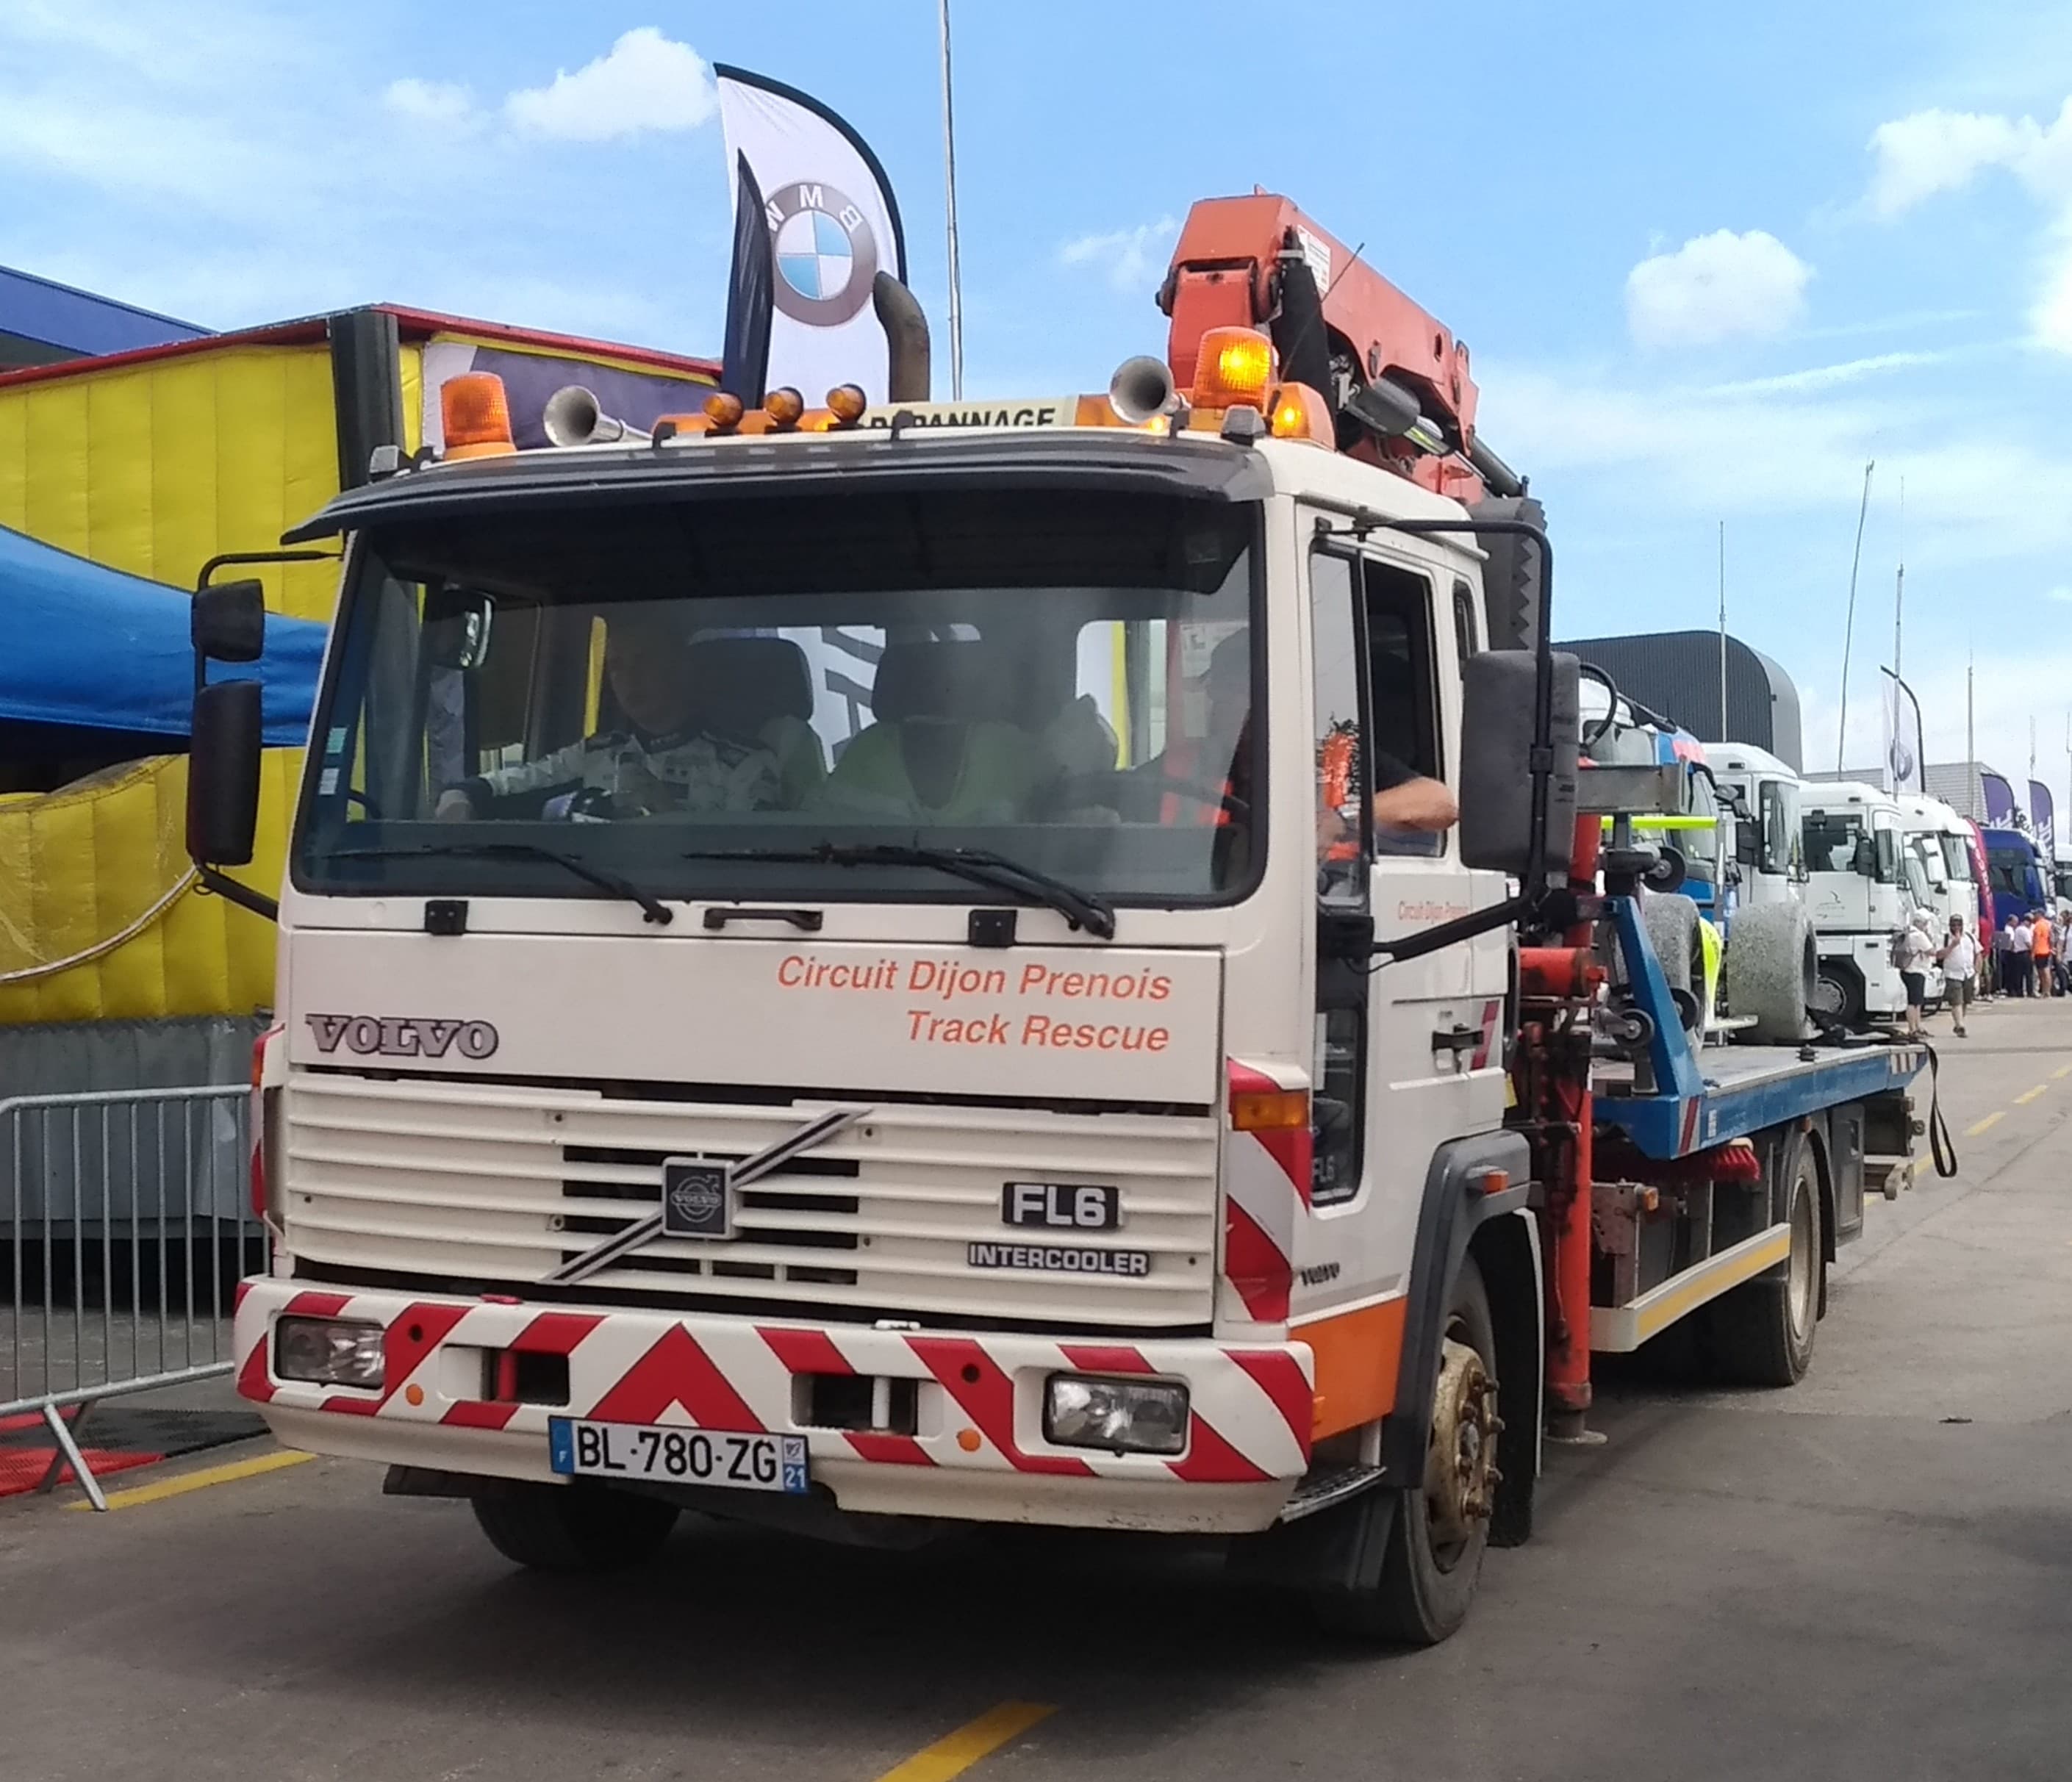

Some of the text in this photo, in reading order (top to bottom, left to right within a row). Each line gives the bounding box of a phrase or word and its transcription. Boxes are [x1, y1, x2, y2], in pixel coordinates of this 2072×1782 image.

[778, 956, 1172, 1000] Circuit Dijon Prenois
[305, 1013, 499, 1060] VOLVO
[906, 1010, 1170, 1051] Track Rescue
[1013, 1184, 1106, 1226] FL6
[969, 1244, 1148, 1274] INTERCOOLER
[559, 1451, 567, 1463] F
[786, 1468, 806, 1489] 21
